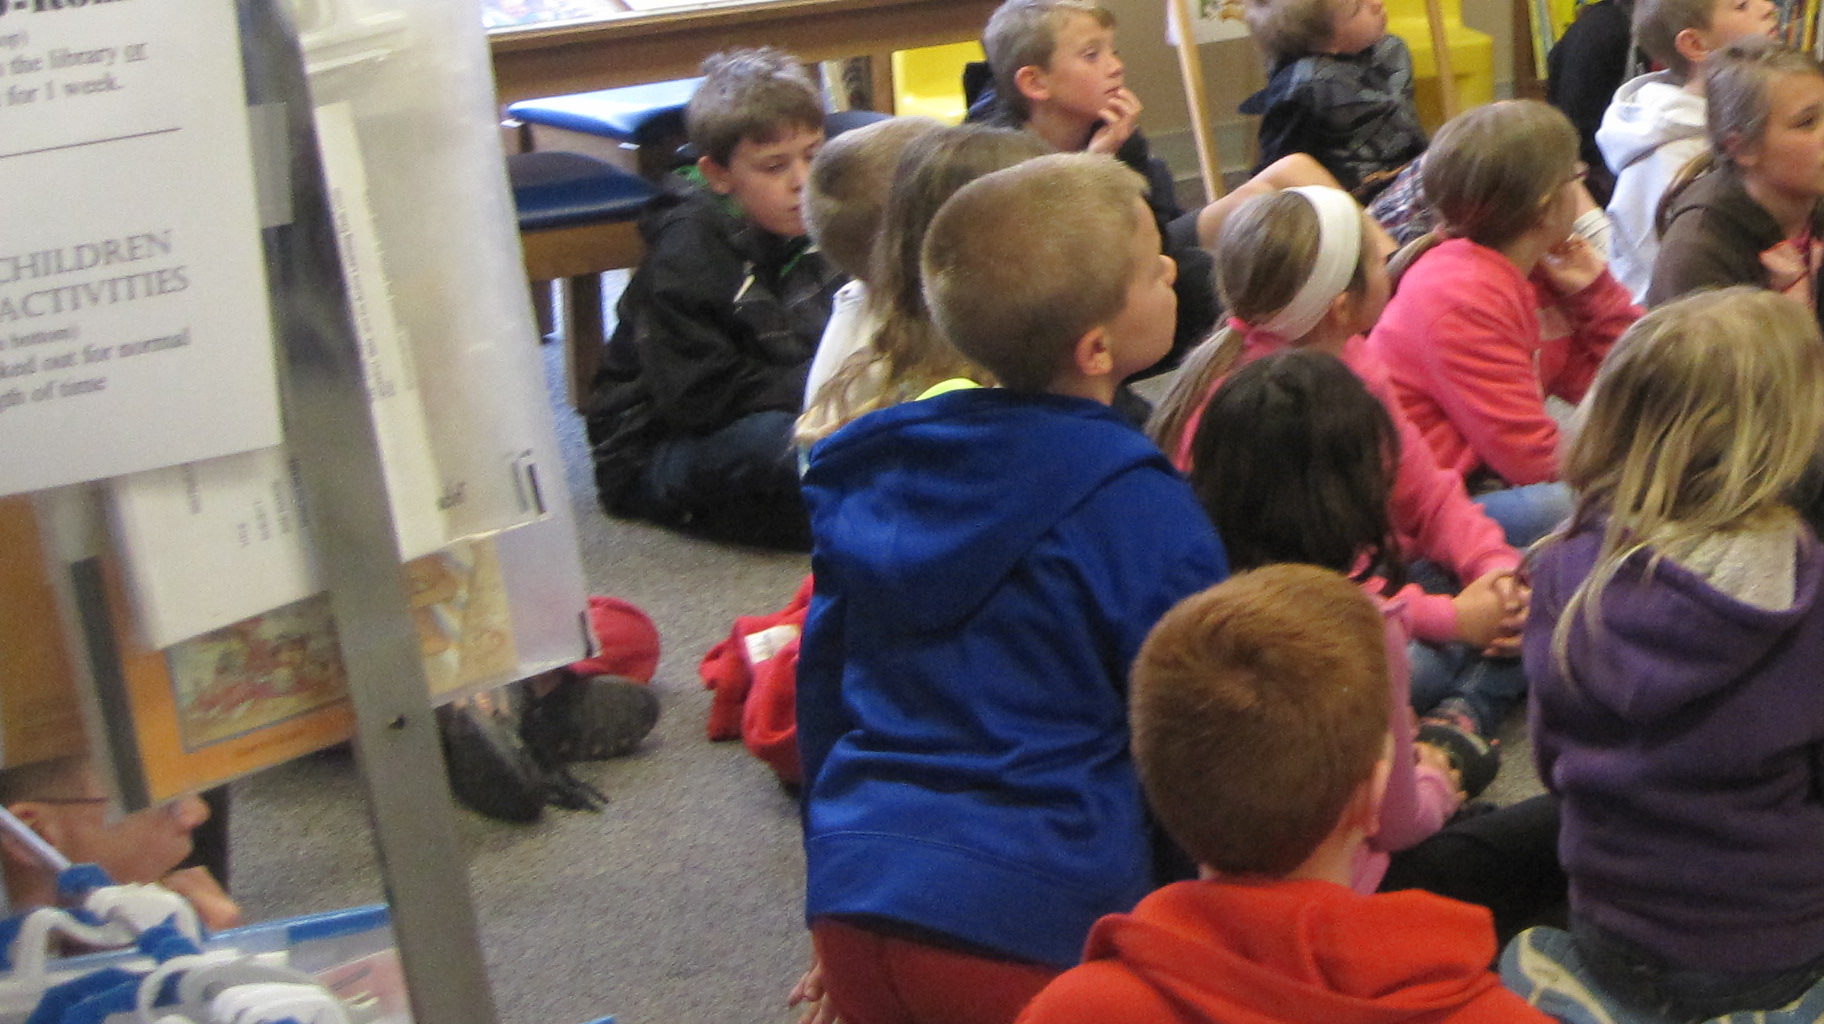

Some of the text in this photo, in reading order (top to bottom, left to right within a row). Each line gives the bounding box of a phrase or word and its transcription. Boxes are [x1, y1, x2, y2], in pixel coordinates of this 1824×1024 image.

[48, 47, 118, 71] library
[7, 85, 40, 106] for
[0, 265, 190, 322] ACTIVITIES
[83, 343, 113, 365] for
[119, 327, 191, 358] normal
[31, 380, 54, 403] of
